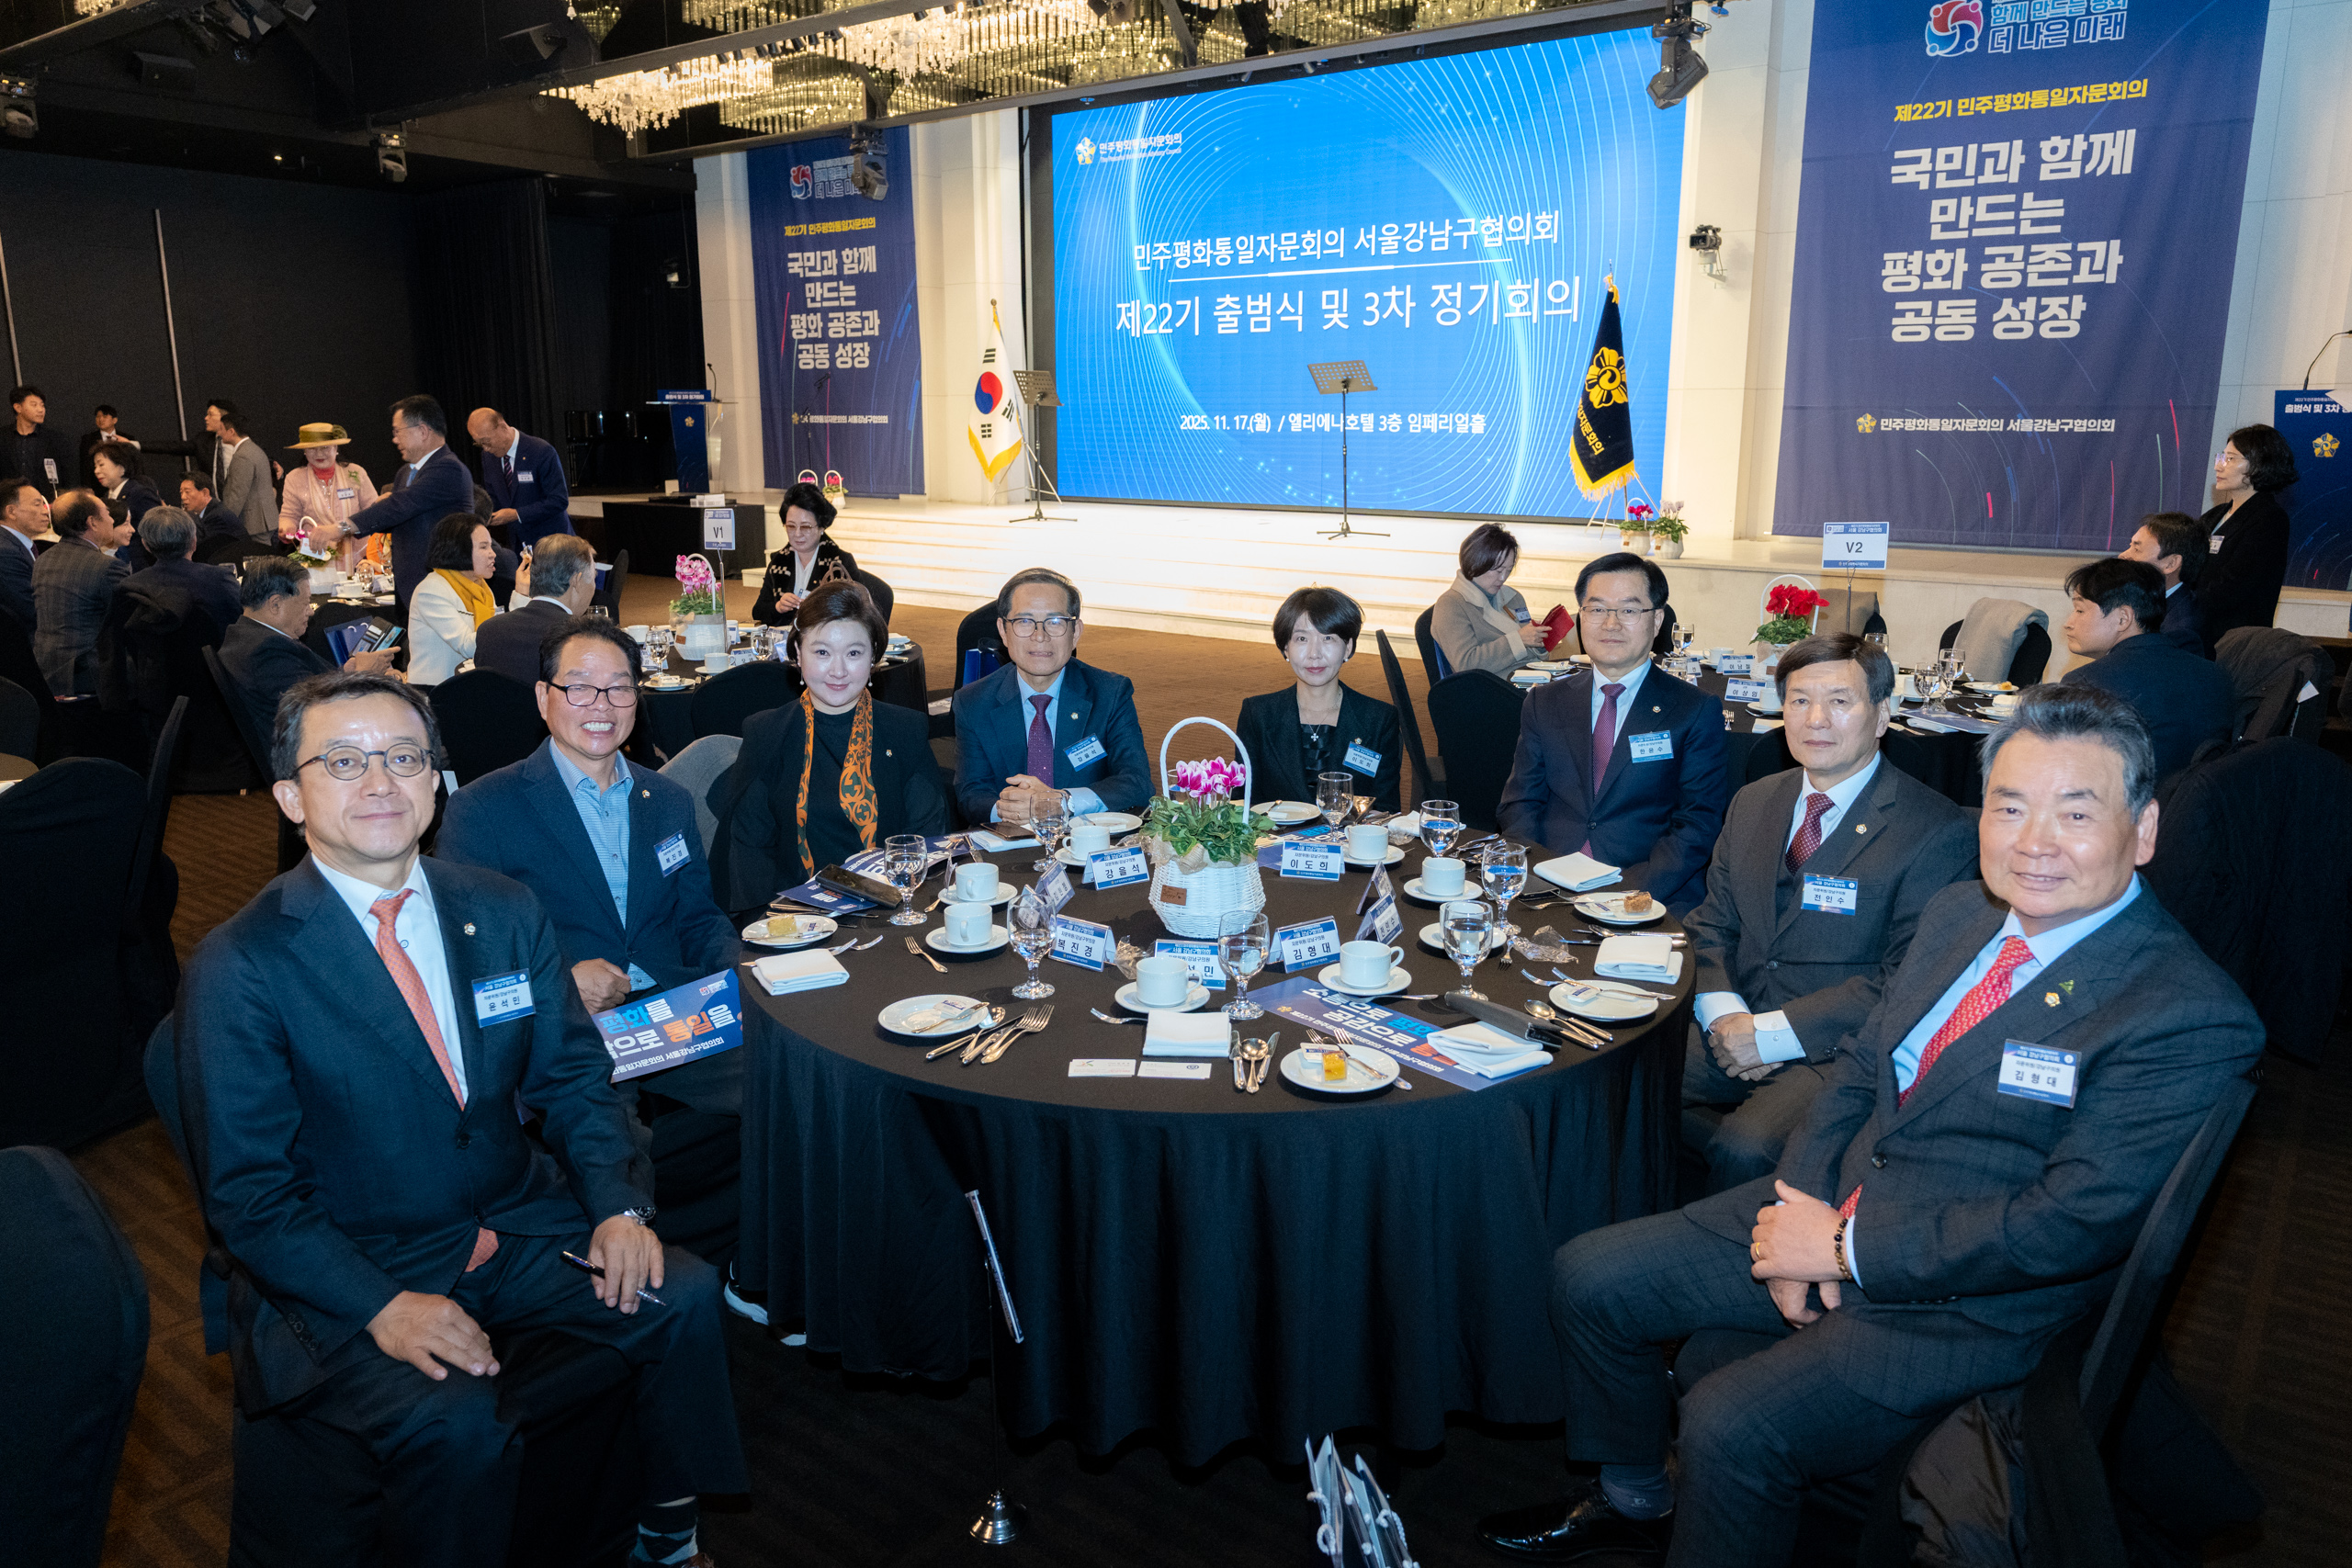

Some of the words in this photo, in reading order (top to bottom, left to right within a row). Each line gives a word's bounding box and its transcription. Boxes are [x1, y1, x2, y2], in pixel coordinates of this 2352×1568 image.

[1988, 26, 2013, 53] 더
[2018, 19, 2069, 50] 나은
[2073, 11, 2127, 43] 미래
[1894, 99, 1952, 122] 제22기
[1957, 78, 2148, 117] 민주평화통일자문회의
[1890, 139, 2025, 190] 국민과
[2039, 129, 2136, 181] 함께
[1930, 193, 2065, 241] 만드는
[1134, 227, 1345, 271] 민주평화통일자문회의
[1354, 210, 1559, 256] 서울강남구협의회
[787, 249, 838, 277] 국민과
[842, 245, 877, 275] 함께
[1881, 249, 1968, 293] 평화
[1980, 239, 2123, 288] 공존과
[805, 280, 856, 309] 만드는
[1115, 296, 1200, 338] 제22기
[1213, 290, 1304, 334] 출범식
[1321, 288, 1350, 331] 및
[1363, 284, 1417, 328] 3차
[1430, 276, 1580, 326] 정기회의
[790, 312, 823, 339] 평화
[828, 310, 880, 338] 공존과
[1891, 299, 1977, 343] 공동
[1992, 295, 2086, 340] 성장
[797, 343, 830, 369] 공동
[834, 342, 870, 369] 성장
[2285, 404, 2312, 413] 출범식
[2313, 404, 2323, 413] 및
[2324, 404, 2340, 413] 3차
[1180, 415, 1210, 430] 2025.
[1214, 415, 1230, 431] 11.
[1234, 412, 1271, 434] 17.(월)
[1288, 412, 1374, 434] 엘리에나호텔
[1378, 413, 1403, 434] 3층
[1408, 412, 1487, 434] 임페리얼홀
[1880, 418, 2004, 432] 민주평화통일자문회의
[2007, 418, 2116, 433] 서울강남구협의회
[713, 525, 723, 539] V1
[1846, 541, 1863, 554] V2
[1105, 869, 1114, 879] 강
[1118, 866, 1127, 876] 을
[1132, 863, 1140, 873] 석
[1290, 859, 1298, 869] 이
[1305, 860, 1314, 870] 도
[1319, 861, 1329, 872] 희
[1814, 894, 1821, 902] 전
[1057, 938, 1066, 951] 복
[1070, 942, 1080, 953] 진
[1084, 945, 1092, 958] 경
[1293, 949, 1303, 961] 김
[1307, 946, 1317, 957] 형
[1321, 942, 1331, 954] 대
[1204, 965, 1214, 977] 민
[513, 996, 520, 1006] 민
[599, 998, 674, 1035] 평화를
[662, 1003, 736, 1043] 통일을
[1322, 1010, 1418, 1047] 공감으로
[1386, 1017, 1439, 1039] 평화
[665, 1036, 725, 1060] 서울강남구협의회
[2015, 1070, 2025, 1081] 김
[2031, 1073, 2040, 1084] 형
